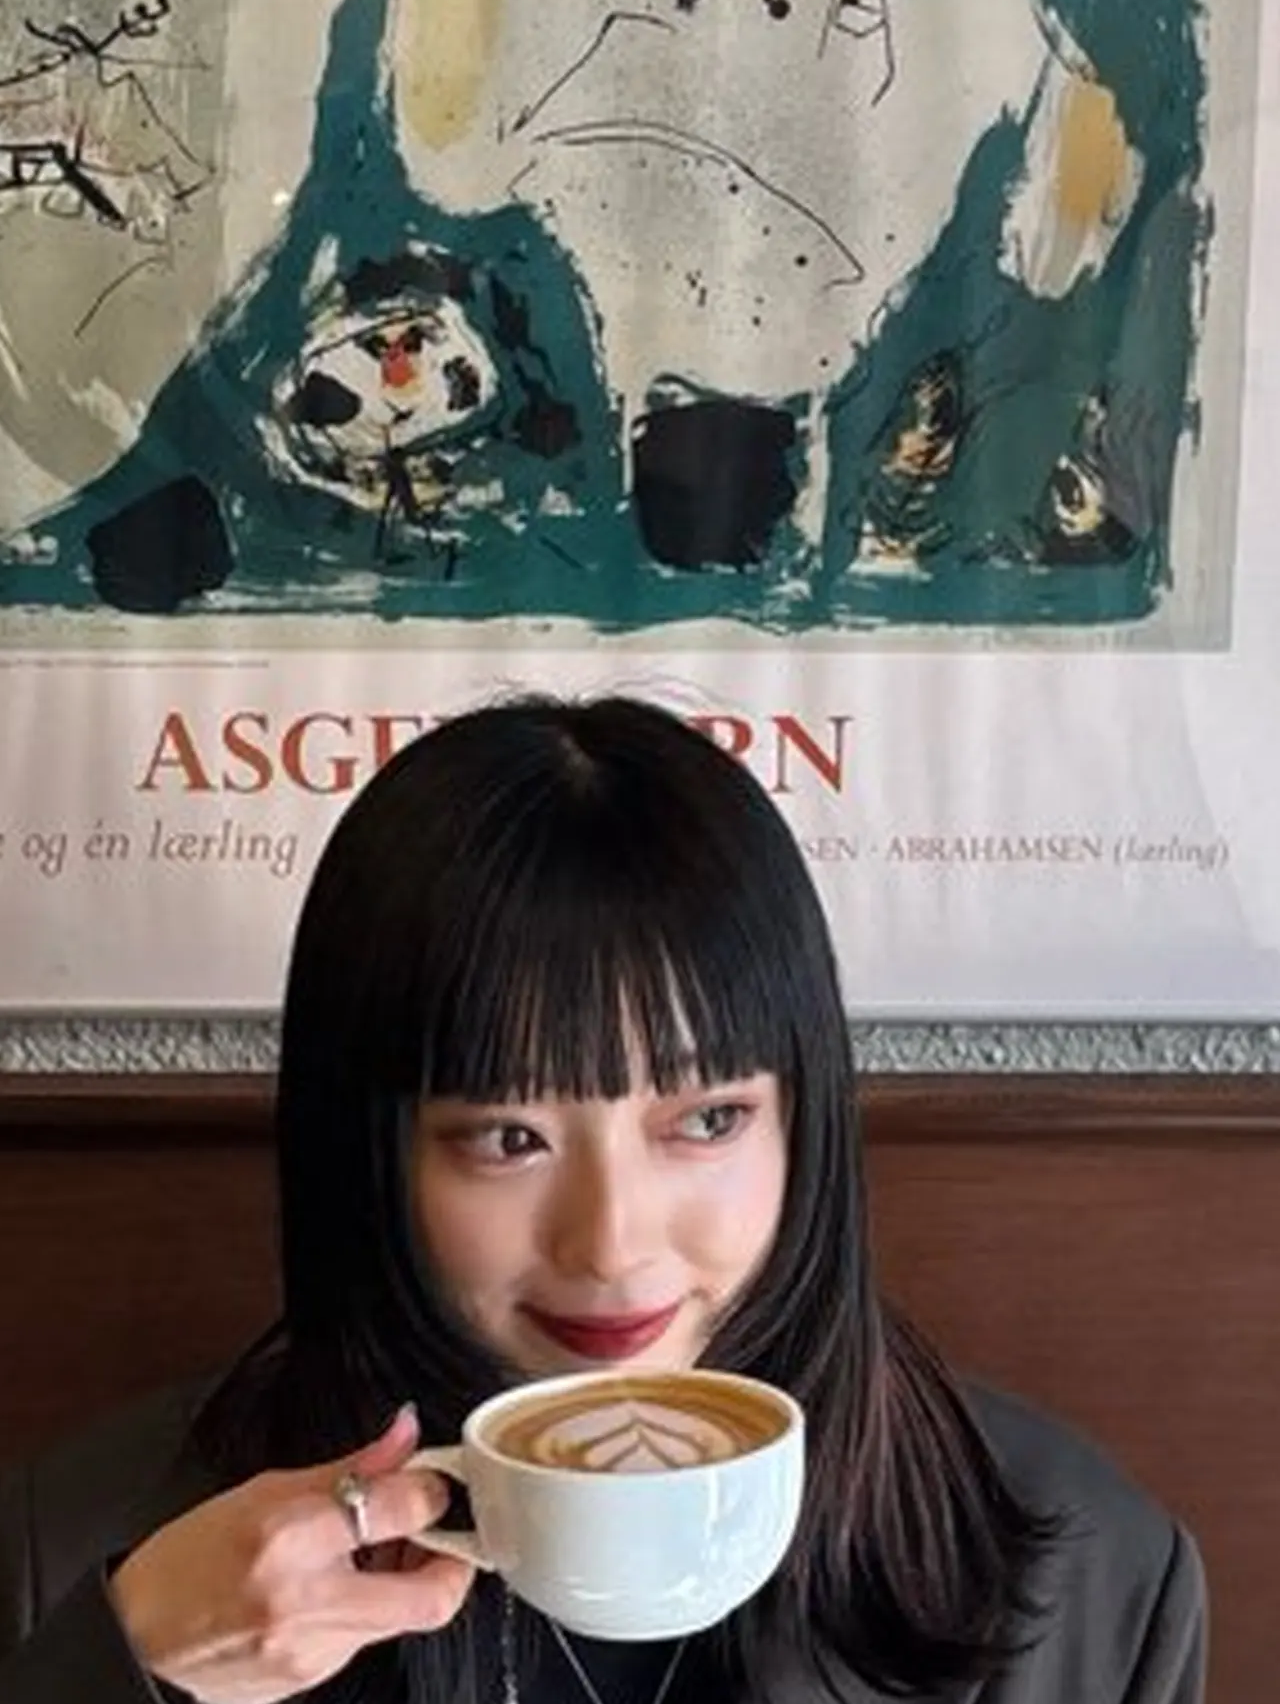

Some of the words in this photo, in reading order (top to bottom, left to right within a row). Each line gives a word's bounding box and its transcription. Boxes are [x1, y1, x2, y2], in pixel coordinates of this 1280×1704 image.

[20, 831, 68, 879] og
[82, 817, 131, 861] én
[147, 817, 299, 879] lærling
[885, 835, 1103, 864] ABRAHAMSEN
